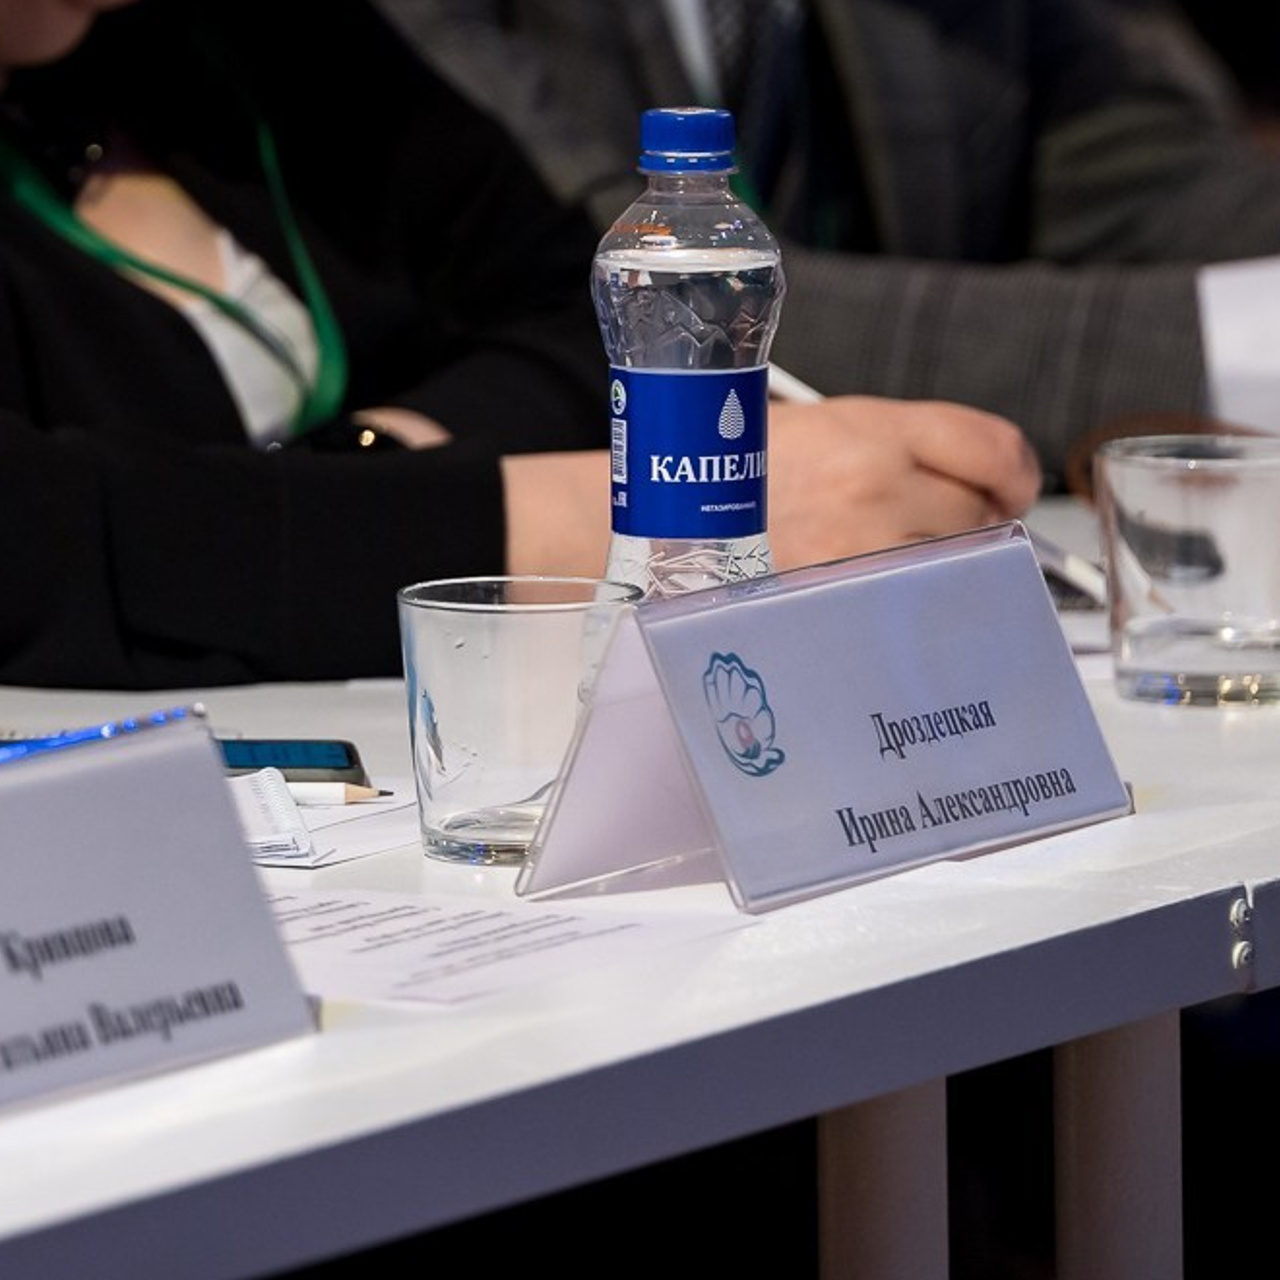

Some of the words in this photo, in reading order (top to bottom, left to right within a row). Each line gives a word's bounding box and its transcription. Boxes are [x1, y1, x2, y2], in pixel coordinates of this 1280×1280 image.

[869, 700, 997, 760] Дроздецкая
[834, 805, 917, 853] Ирина
[916, 768, 1077, 830] Александровна
